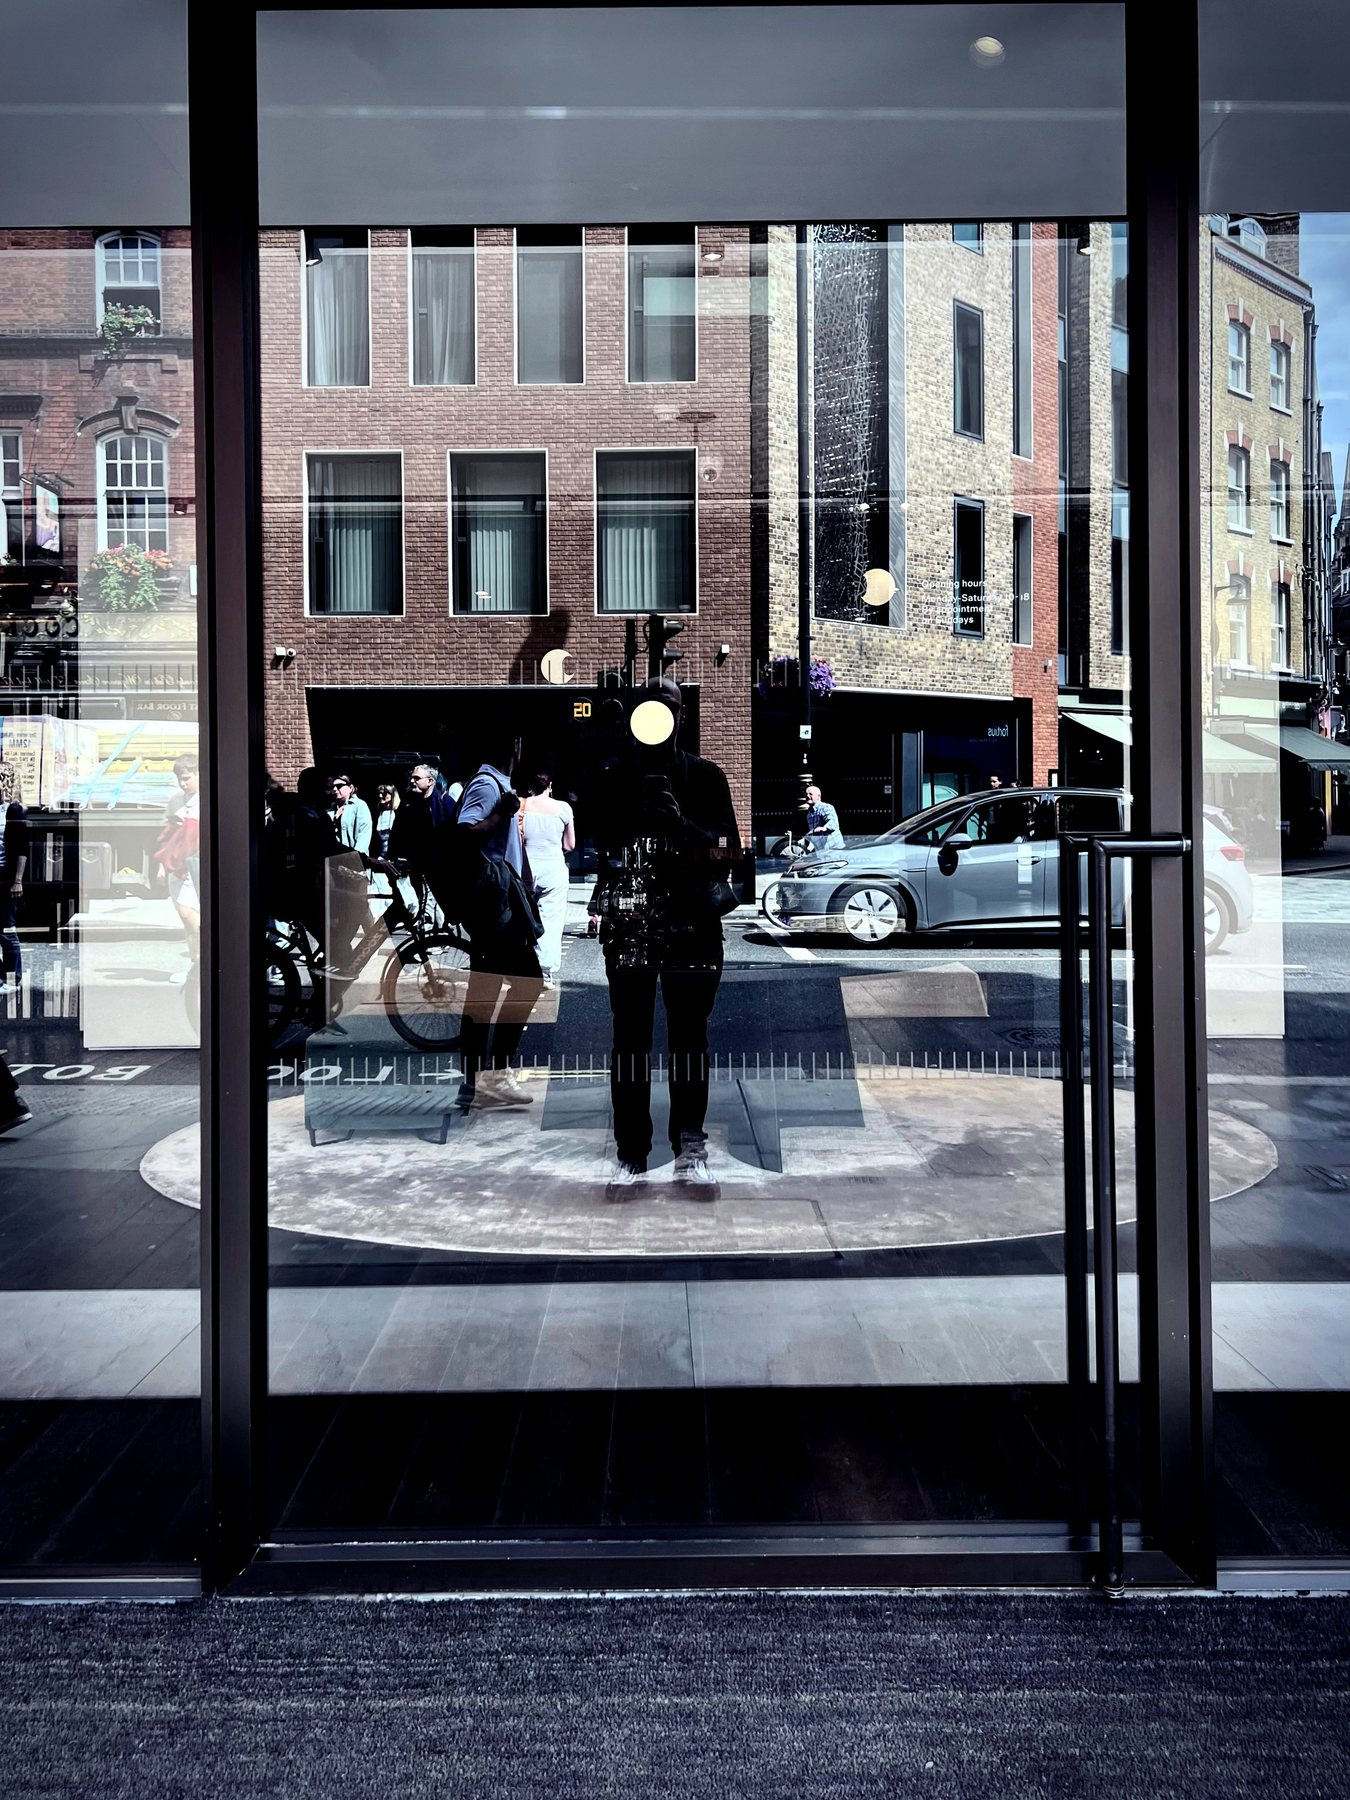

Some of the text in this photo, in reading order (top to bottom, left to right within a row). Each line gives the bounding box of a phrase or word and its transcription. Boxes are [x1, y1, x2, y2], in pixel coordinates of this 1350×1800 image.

[921, 579, 988, 589] Opening hours
[936, 605, 993, 614] appointment
[935, 616, 974, 625] Sundays
